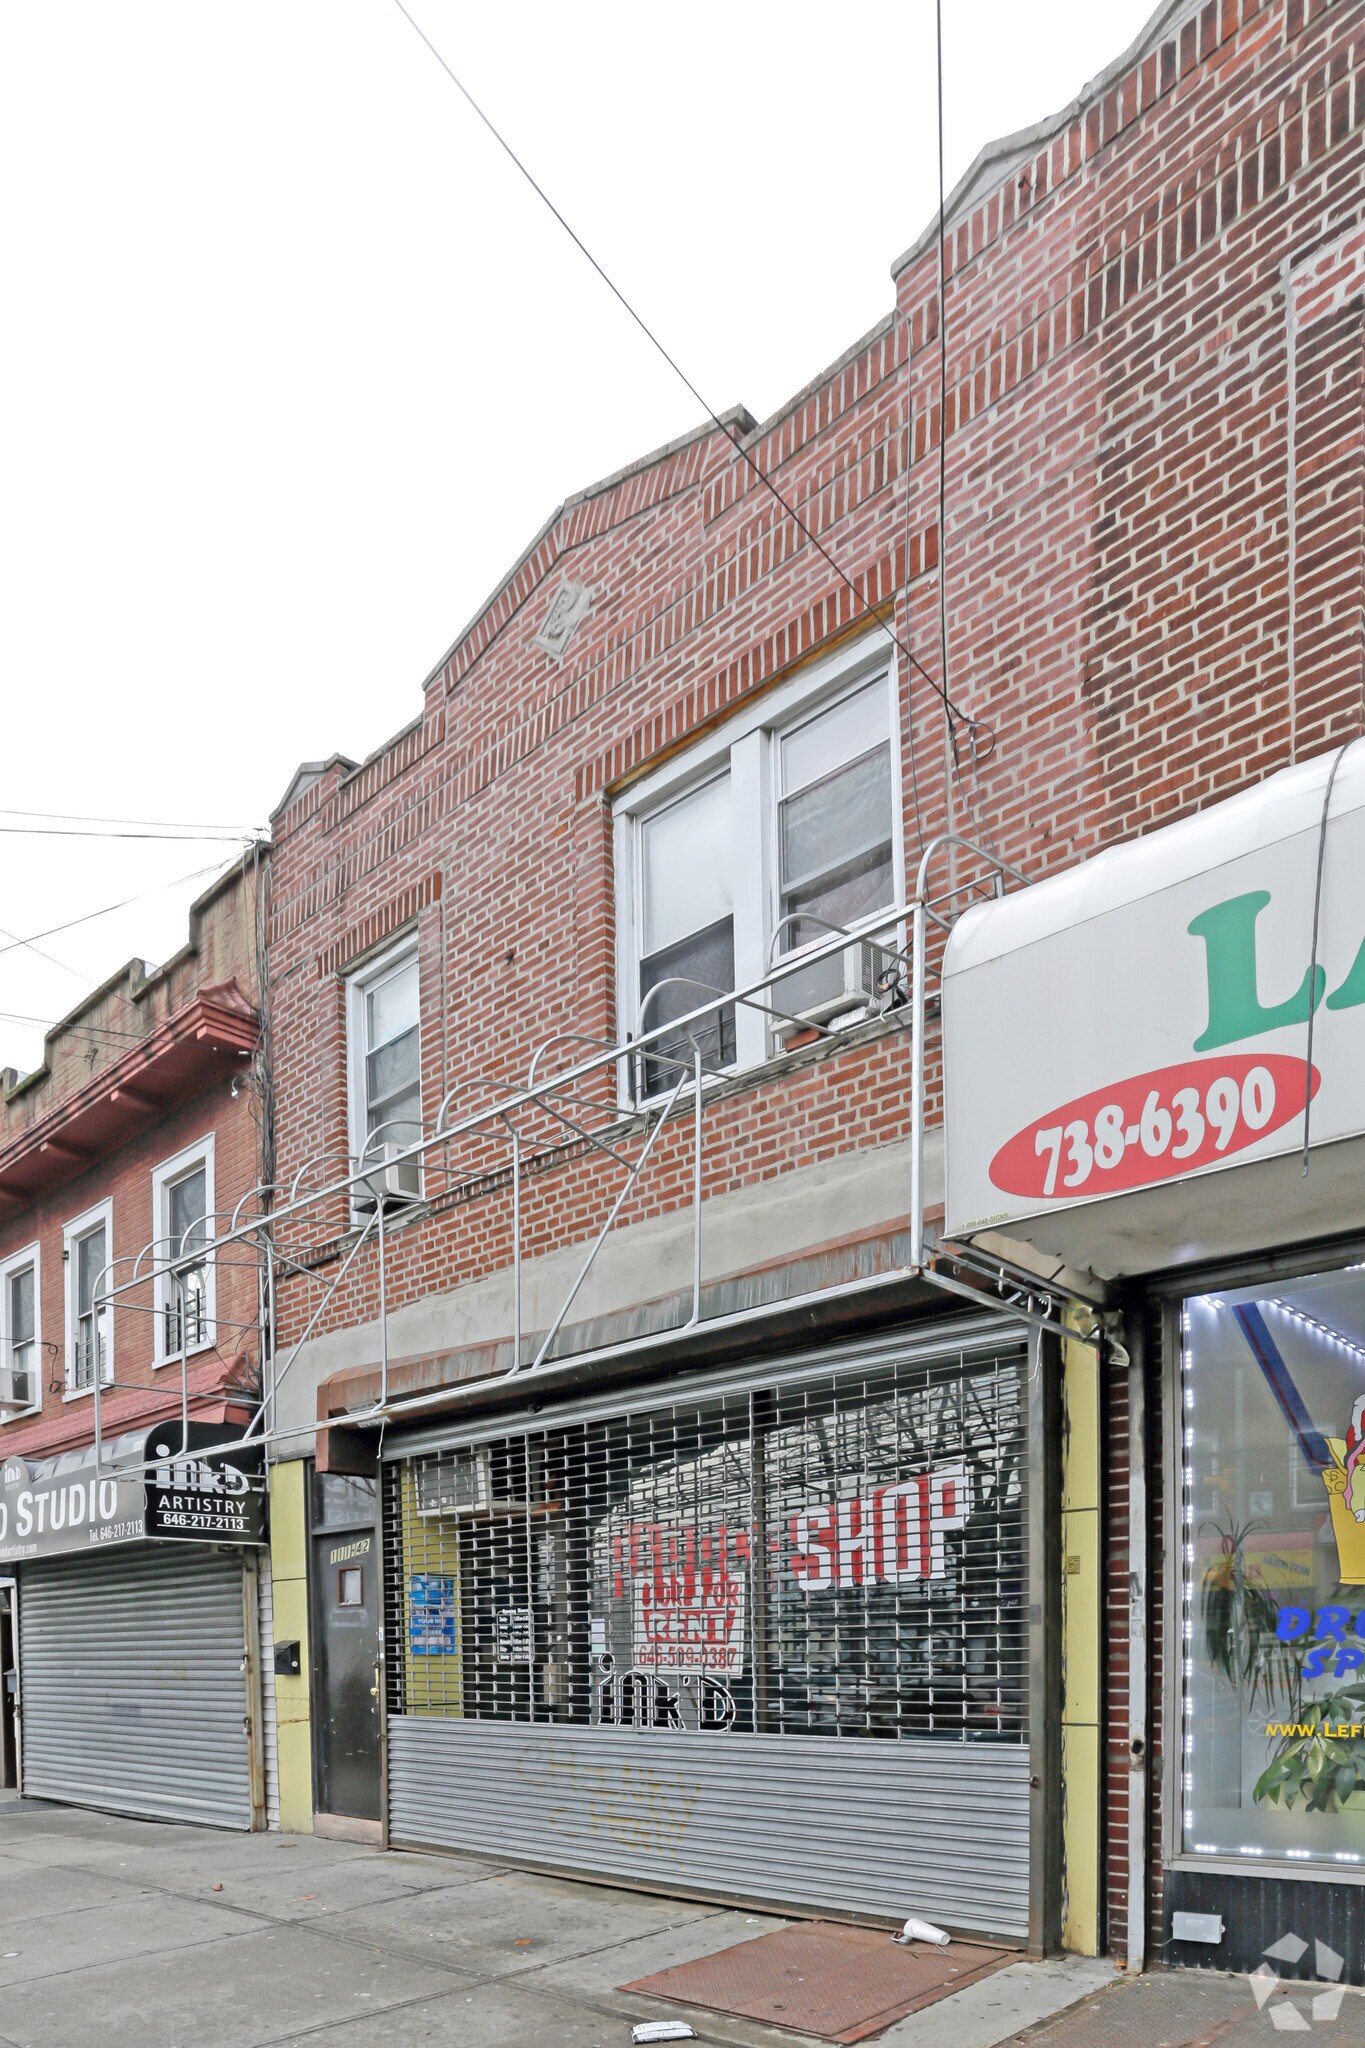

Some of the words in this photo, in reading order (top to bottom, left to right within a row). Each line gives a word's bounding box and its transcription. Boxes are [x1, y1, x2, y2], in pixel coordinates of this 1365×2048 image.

[1035, 1067, 1276, 1195] 738-6390
[16, 1479, 117, 1537] STUDIO
[159, 1495, 246, 1514] ARTISTRY
[100, 1519, 143, 1540] 646-217-2113
[163, 1513, 244, 1530] 646-217-2113
[796, 1463, 970, 1591] SHOP
[648, 1612, 727, 1641] RENT
